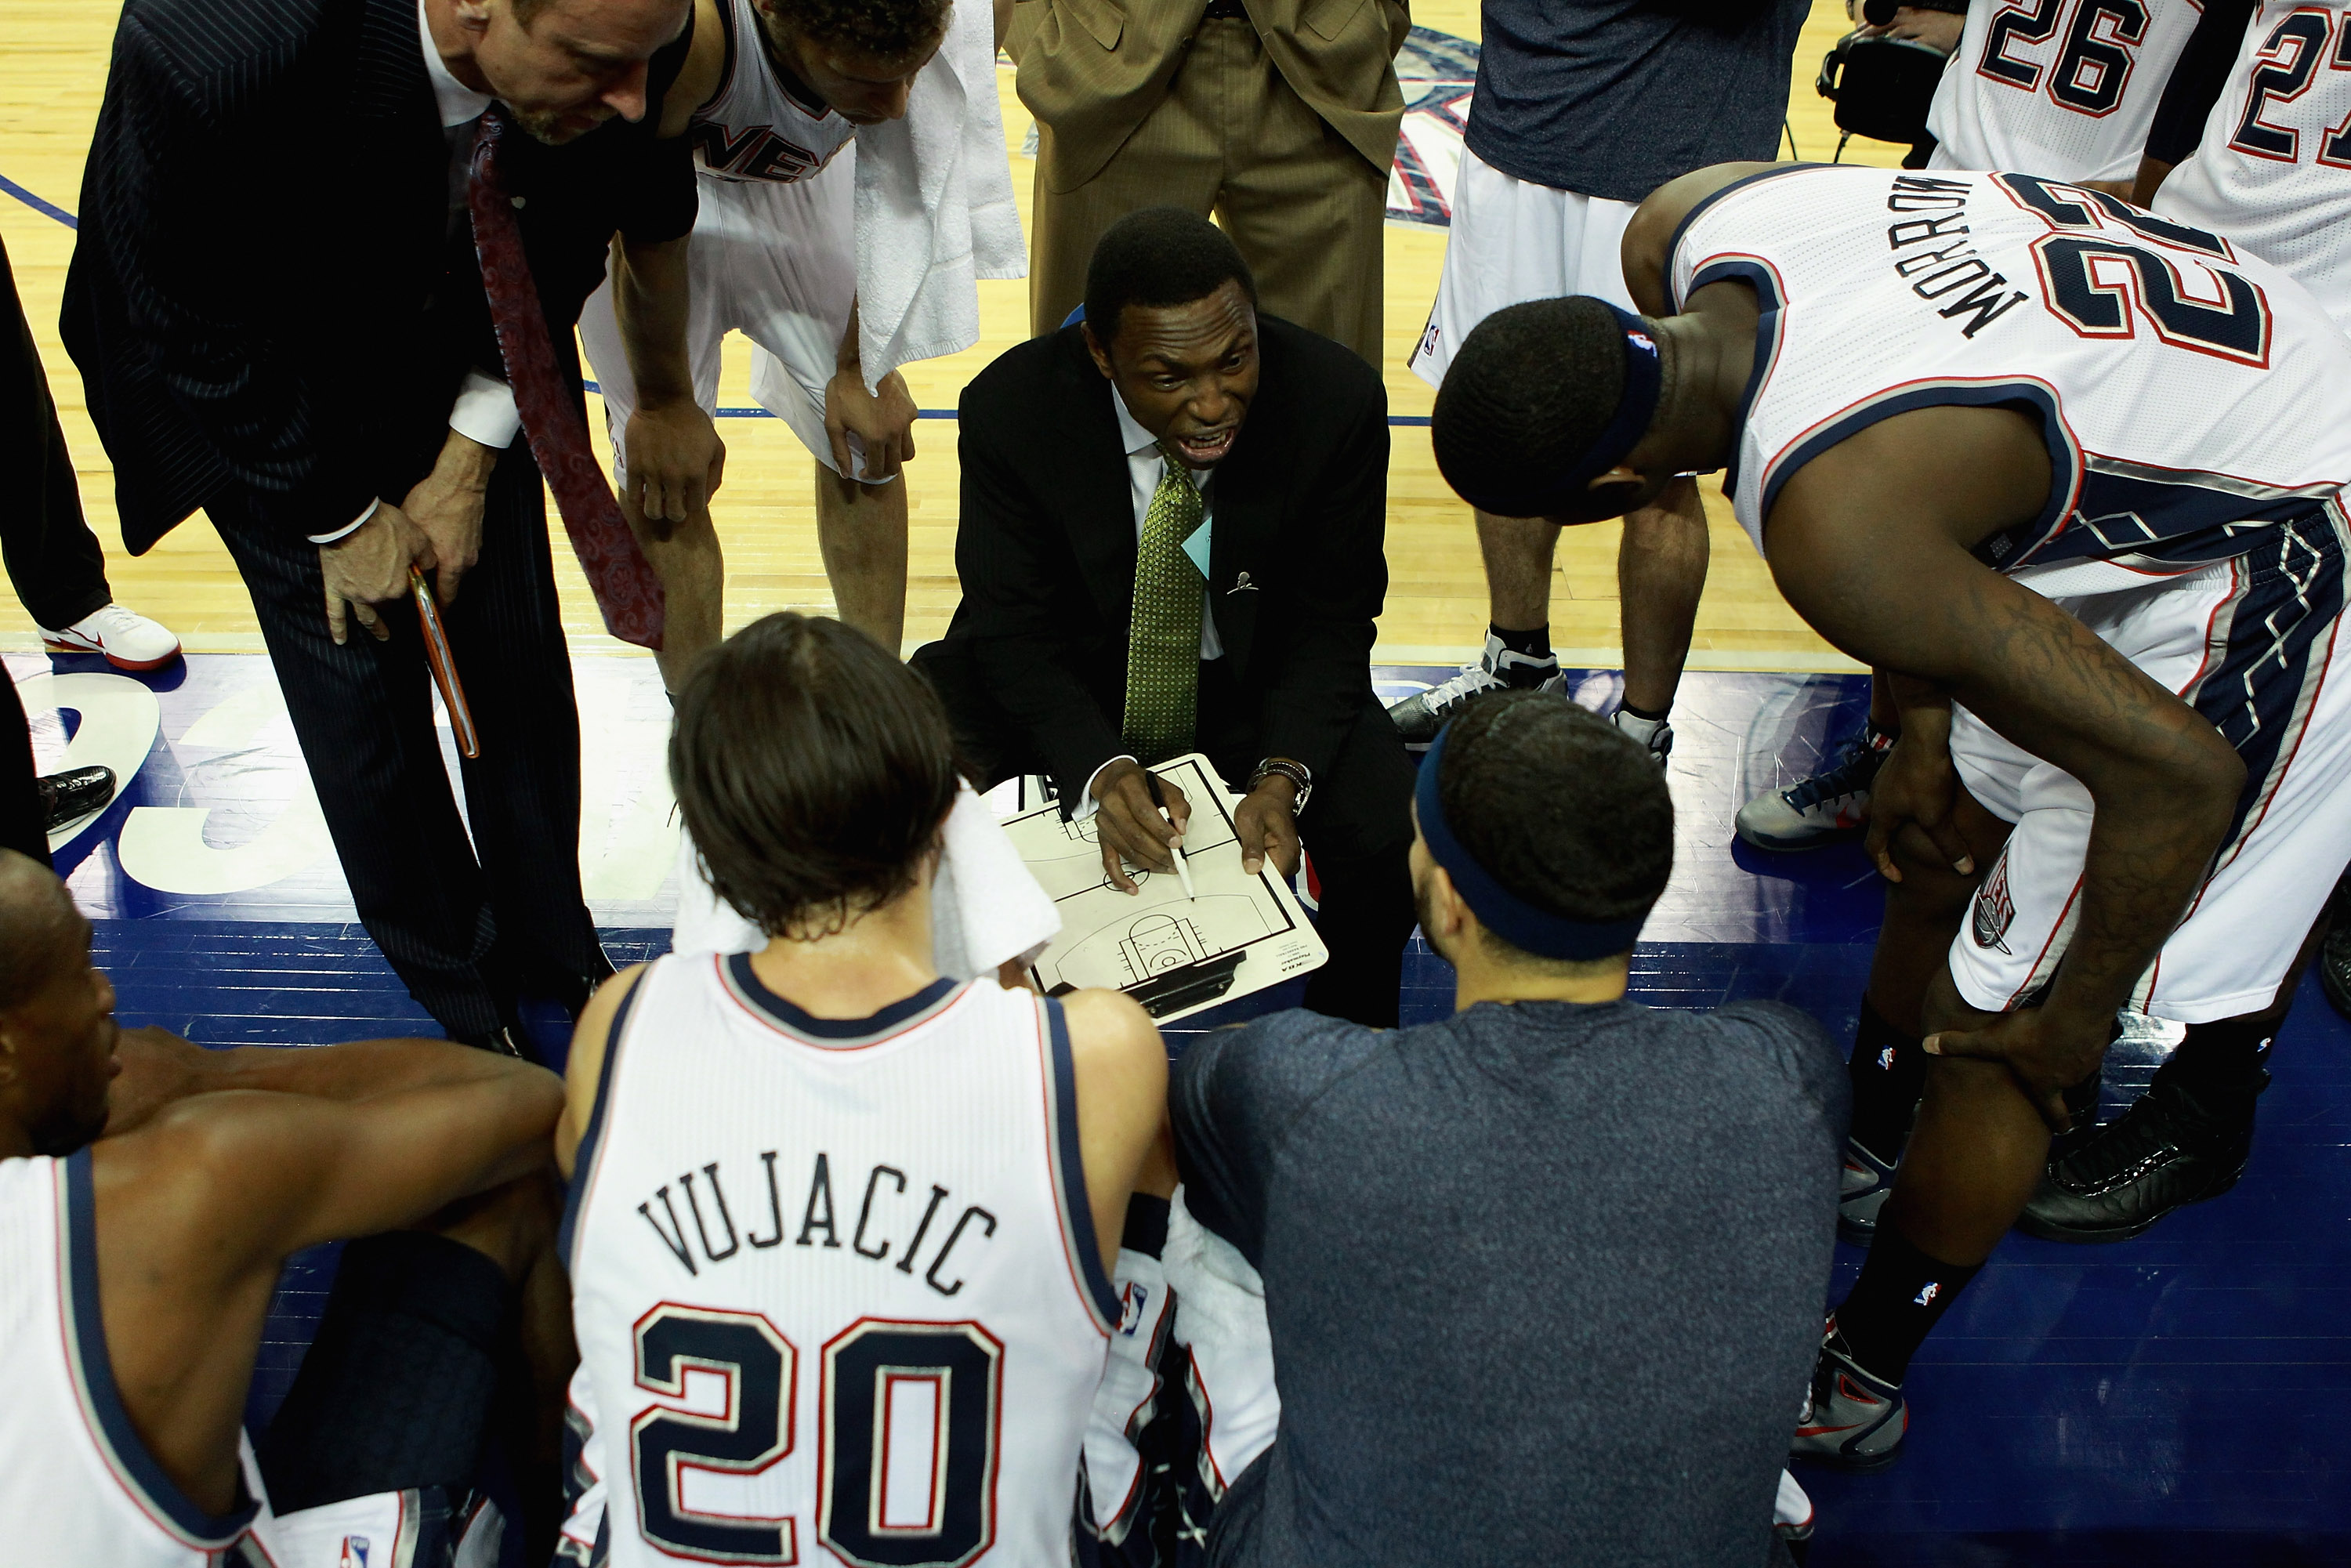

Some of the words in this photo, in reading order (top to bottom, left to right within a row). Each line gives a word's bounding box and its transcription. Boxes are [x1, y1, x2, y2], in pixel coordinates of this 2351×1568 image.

[1976, 0, 2152, 118] 26
[692, 120, 820, 183] NE
[1888, 175, 2030, 340] MORROW
[1988, 170, 2273, 370] 22
[1281, 952, 1311, 965] Playmaker
[637, 1150, 998, 1298] VUJACIC
[630, 1301, 1005, 1568] 20
